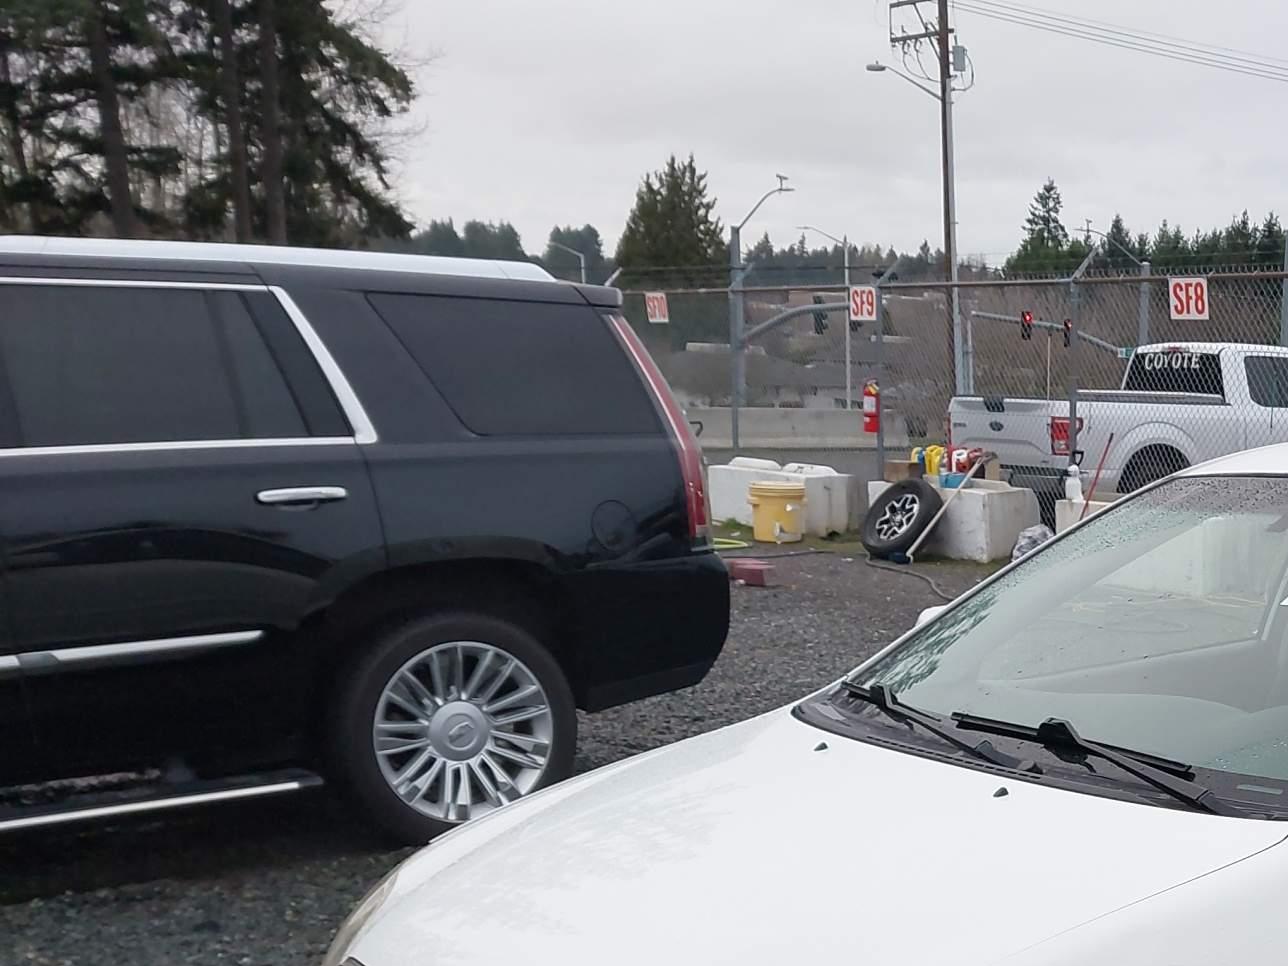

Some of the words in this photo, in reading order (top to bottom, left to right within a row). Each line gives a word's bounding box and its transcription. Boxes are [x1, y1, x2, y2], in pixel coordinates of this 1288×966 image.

[646, 295, 667, 319] SF10
[852, 289, 874, 317] SF9
[1172, 281, 1206, 316] SF8
[1145, 352, 1201, 370] COYOTE
